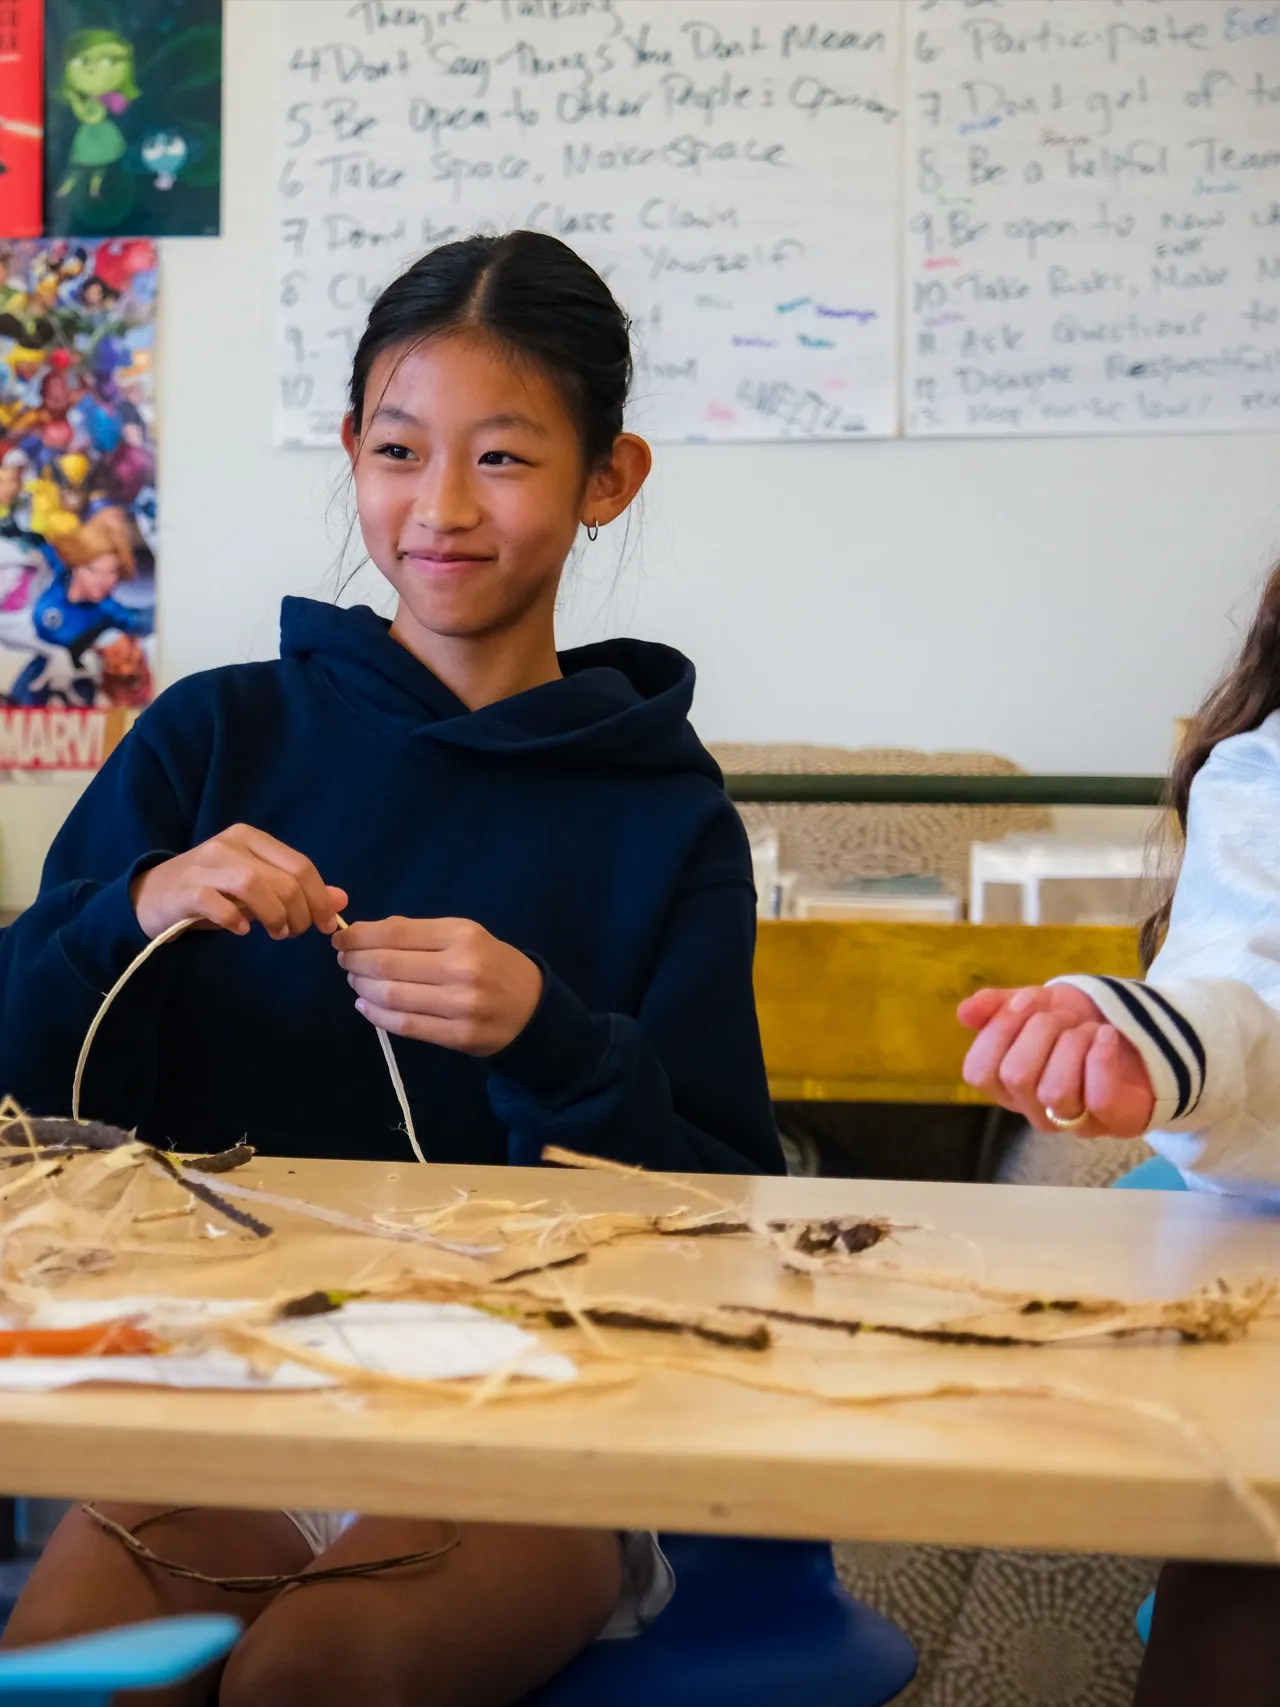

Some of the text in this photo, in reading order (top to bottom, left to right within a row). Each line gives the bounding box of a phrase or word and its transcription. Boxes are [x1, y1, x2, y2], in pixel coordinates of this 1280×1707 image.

[428, 40, 491, 98] Say
[496, 41, 615, 92] Things
[782, 23, 886, 58] Mean
[960, 18, 1214, 64] Participate
[322, 97, 378, 142] Be
[409, 97, 490, 148] Open
[501, 88, 539, 138] to
[557, 89, 652, 124] Other
[917, 90, 942, 127] 7
[316, 151, 406, 199] Take
[563, 143, 657, 178] Make
[968, 144, 1008, 187] Be
[281, 217, 308, 256] 7
[525, 201, 615, 234] Class
[948, 208, 992, 249] Be
[1003, 218, 1078, 260] open
[1090, 200, 1136, 238] to
[639, 238, 806, 283] Yourself
[960, 326, 1024, 358] Ask
